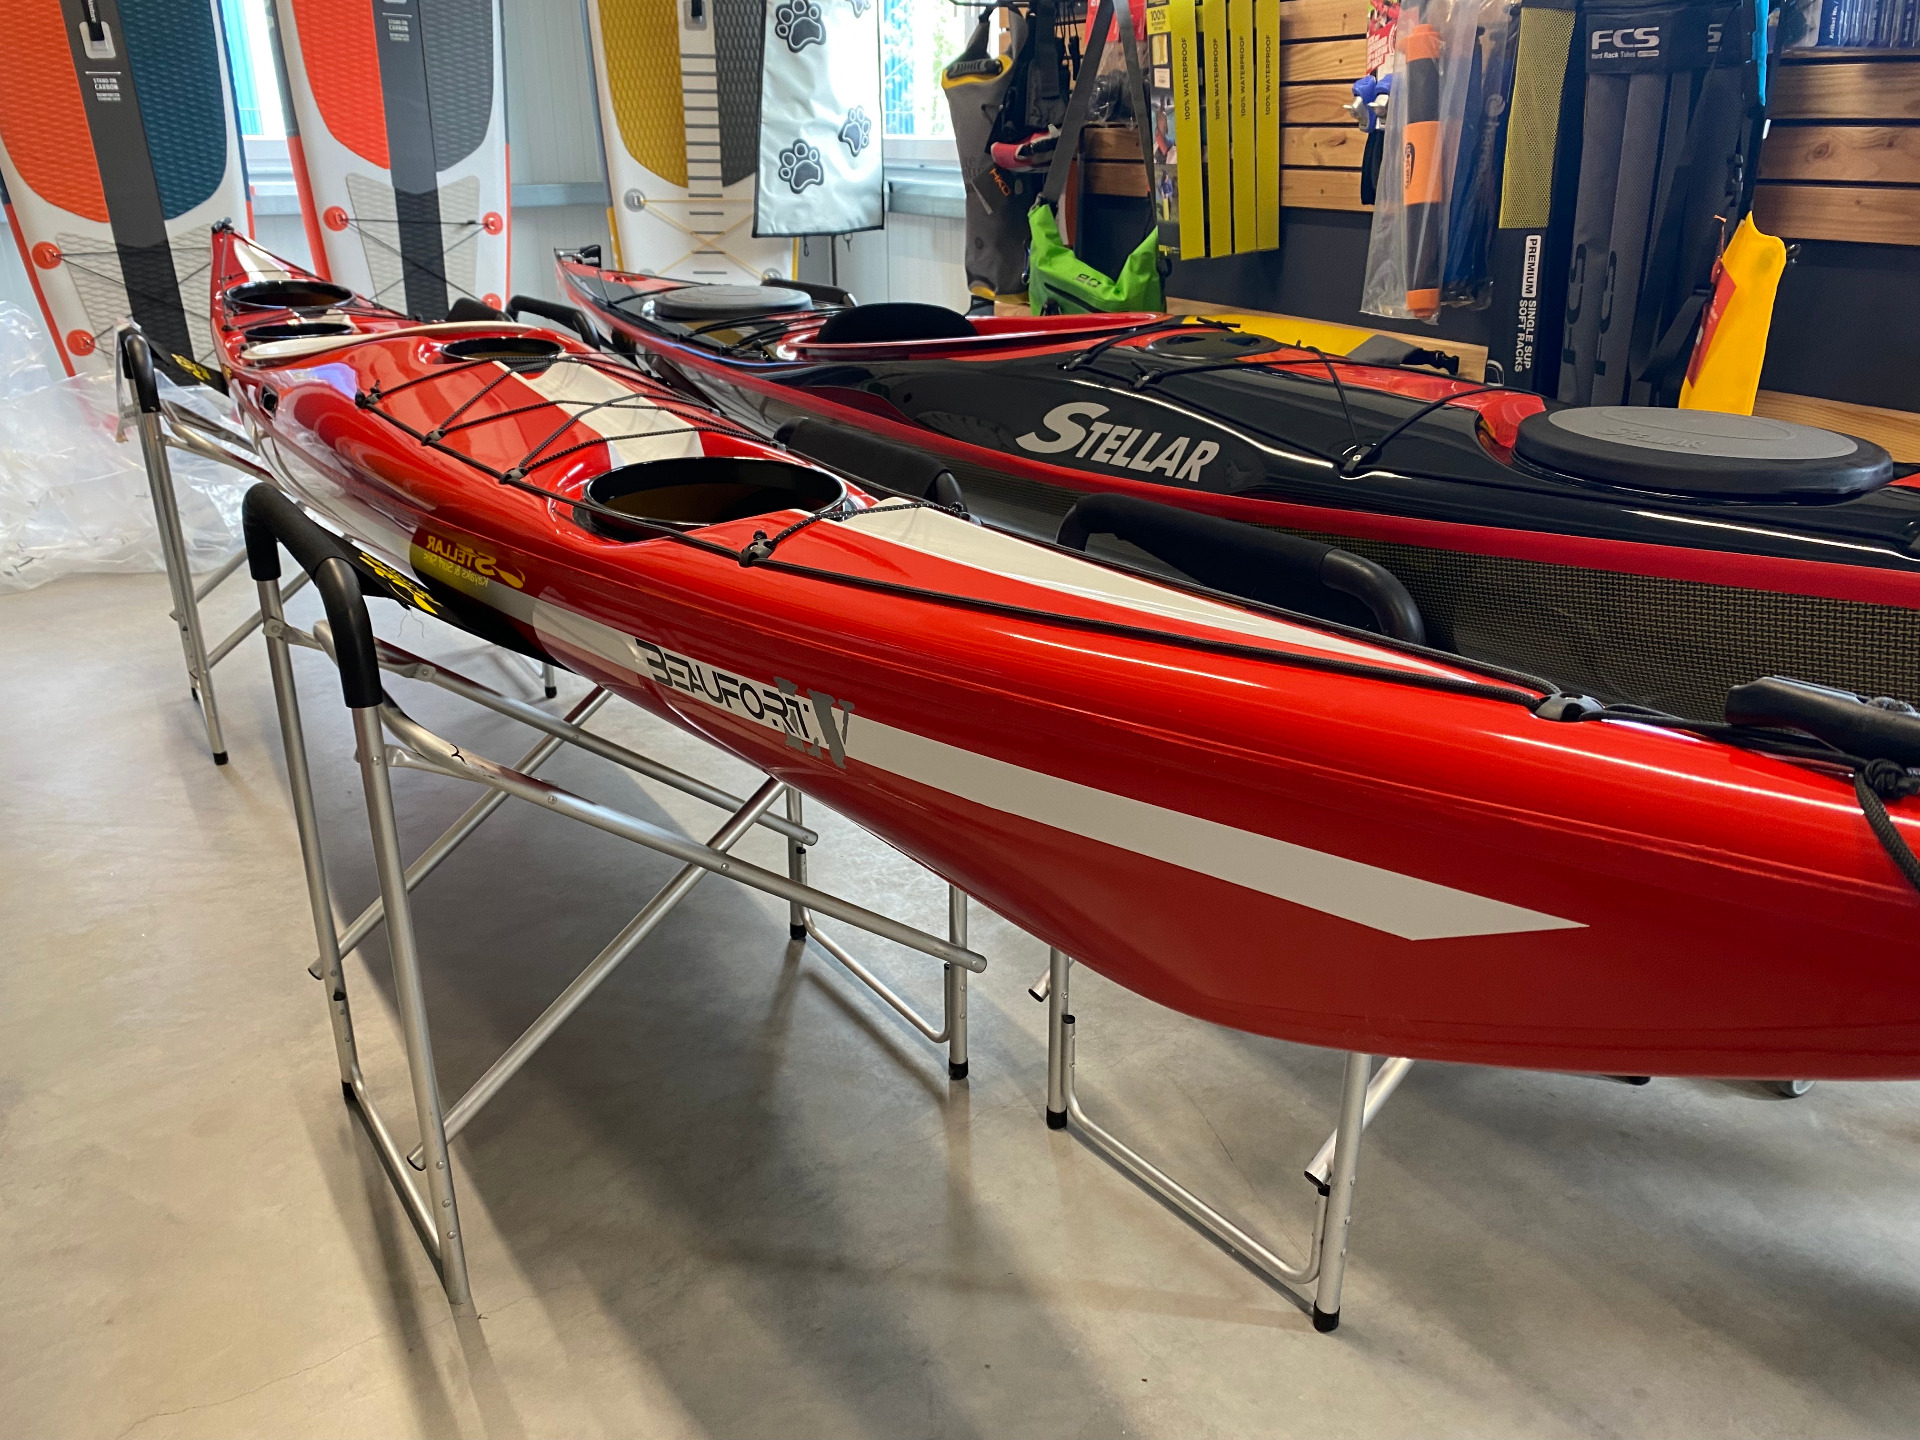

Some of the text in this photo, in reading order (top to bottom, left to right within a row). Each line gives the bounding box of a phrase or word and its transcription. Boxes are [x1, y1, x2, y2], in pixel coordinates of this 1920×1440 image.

[1181, 37, 1190, 97] WATERPROOF
[1591, 27, 1660, 50] FCS
[1604, 51, 1619, 59] Rack
[1620, 50, 1636, 58] Tubes
[1525, 238, 1538, 294] PREMIUM
[1514, 300, 1527, 372] SOFT RACKS
[1523, 300, 1536, 369] SINGLE SUP
[1015, 401, 1220, 483] STELLAR
[635, 638, 811, 740] BEAUFORT
